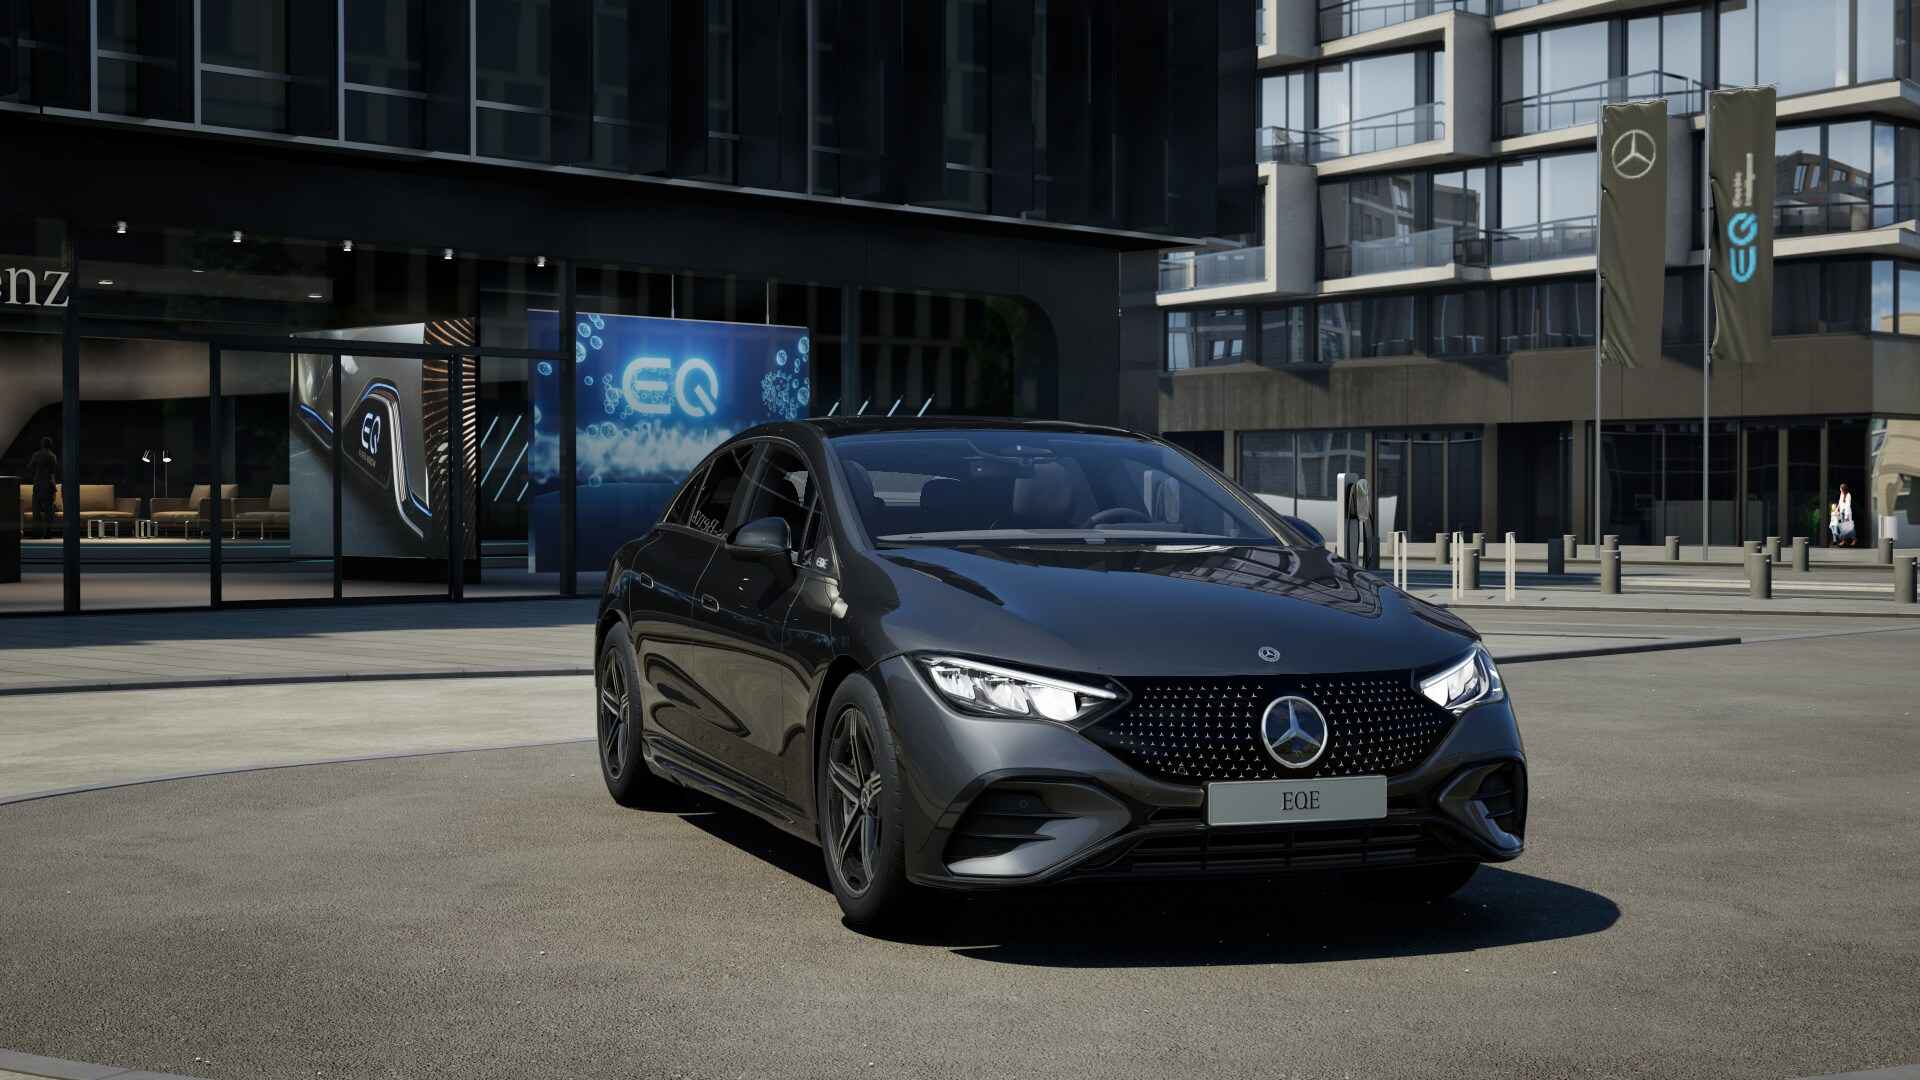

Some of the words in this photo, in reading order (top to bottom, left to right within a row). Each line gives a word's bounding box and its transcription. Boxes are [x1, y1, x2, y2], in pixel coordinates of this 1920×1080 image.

[1728, 212, 1758, 283] EQ
[0, 268, 70, 307] nz
[623, 357, 719, 417] EQ
[361, 412, 381, 455] EQ
[1282, 790, 1320, 810] EQE
